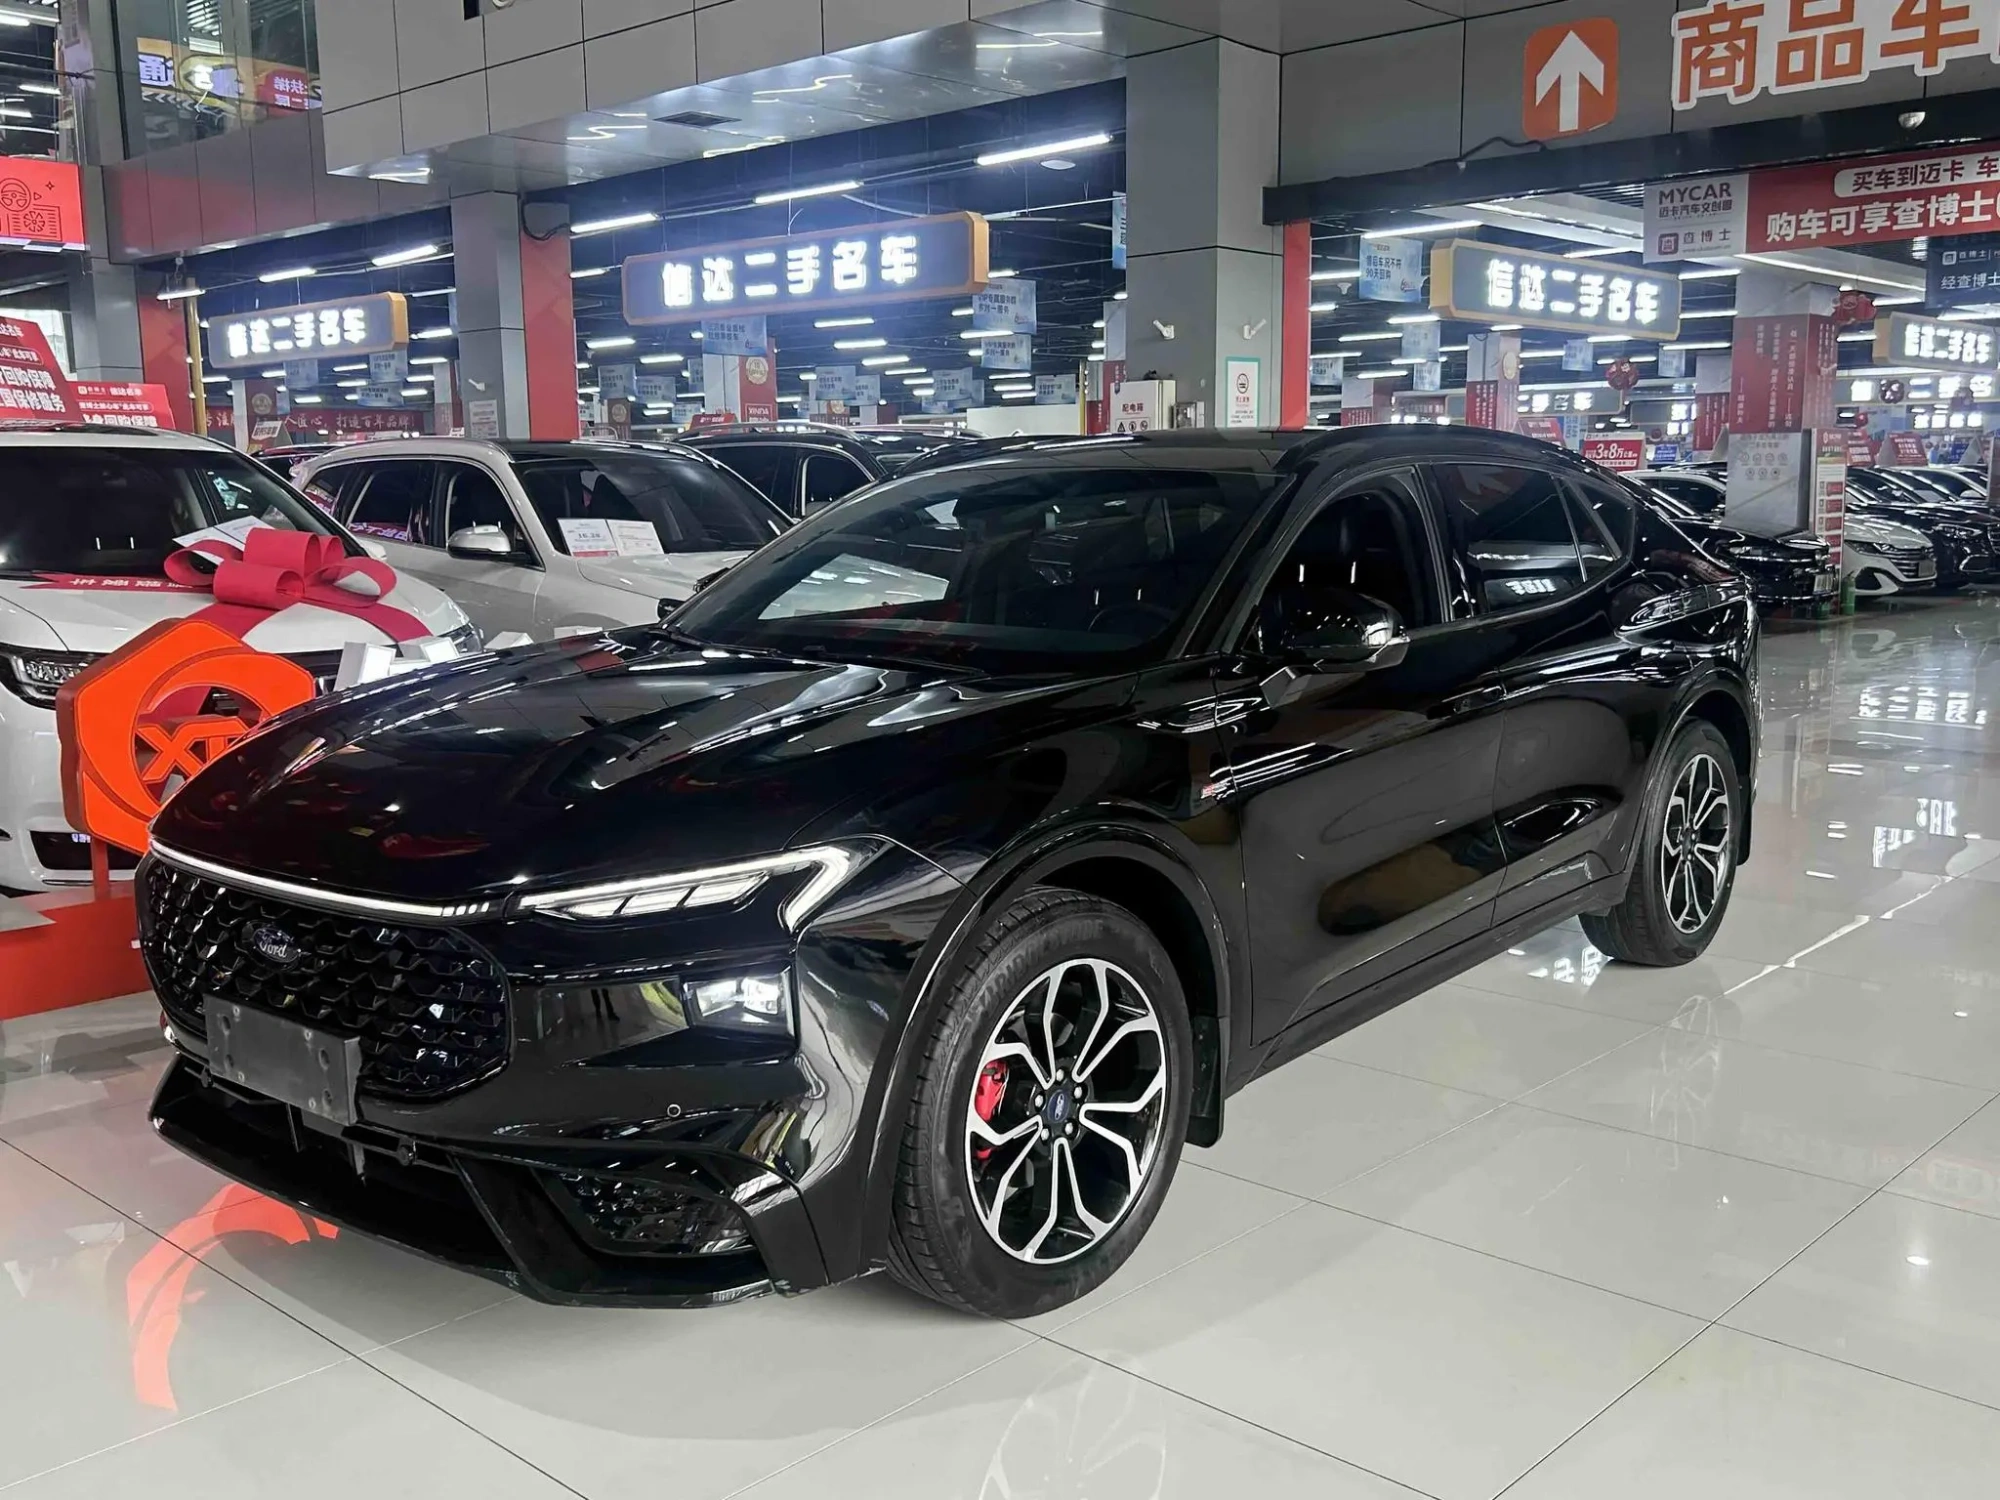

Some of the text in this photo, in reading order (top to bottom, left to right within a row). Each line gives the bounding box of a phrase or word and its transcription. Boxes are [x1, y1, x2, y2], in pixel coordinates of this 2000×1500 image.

[1671, 0, 2000, 110] 商品车
[1658, 183, 1732, 205] MYCAR
[1852, 164, 1965, 193] 买车到迈卡
[1766, 189, 2000, 243] 购车可享查博士
[661, 235, 918, 308] 信达二手名车
[1486, 258, 1660, 325] 信达二手名车
[1122, 402, 1144, 413] 配电箱
